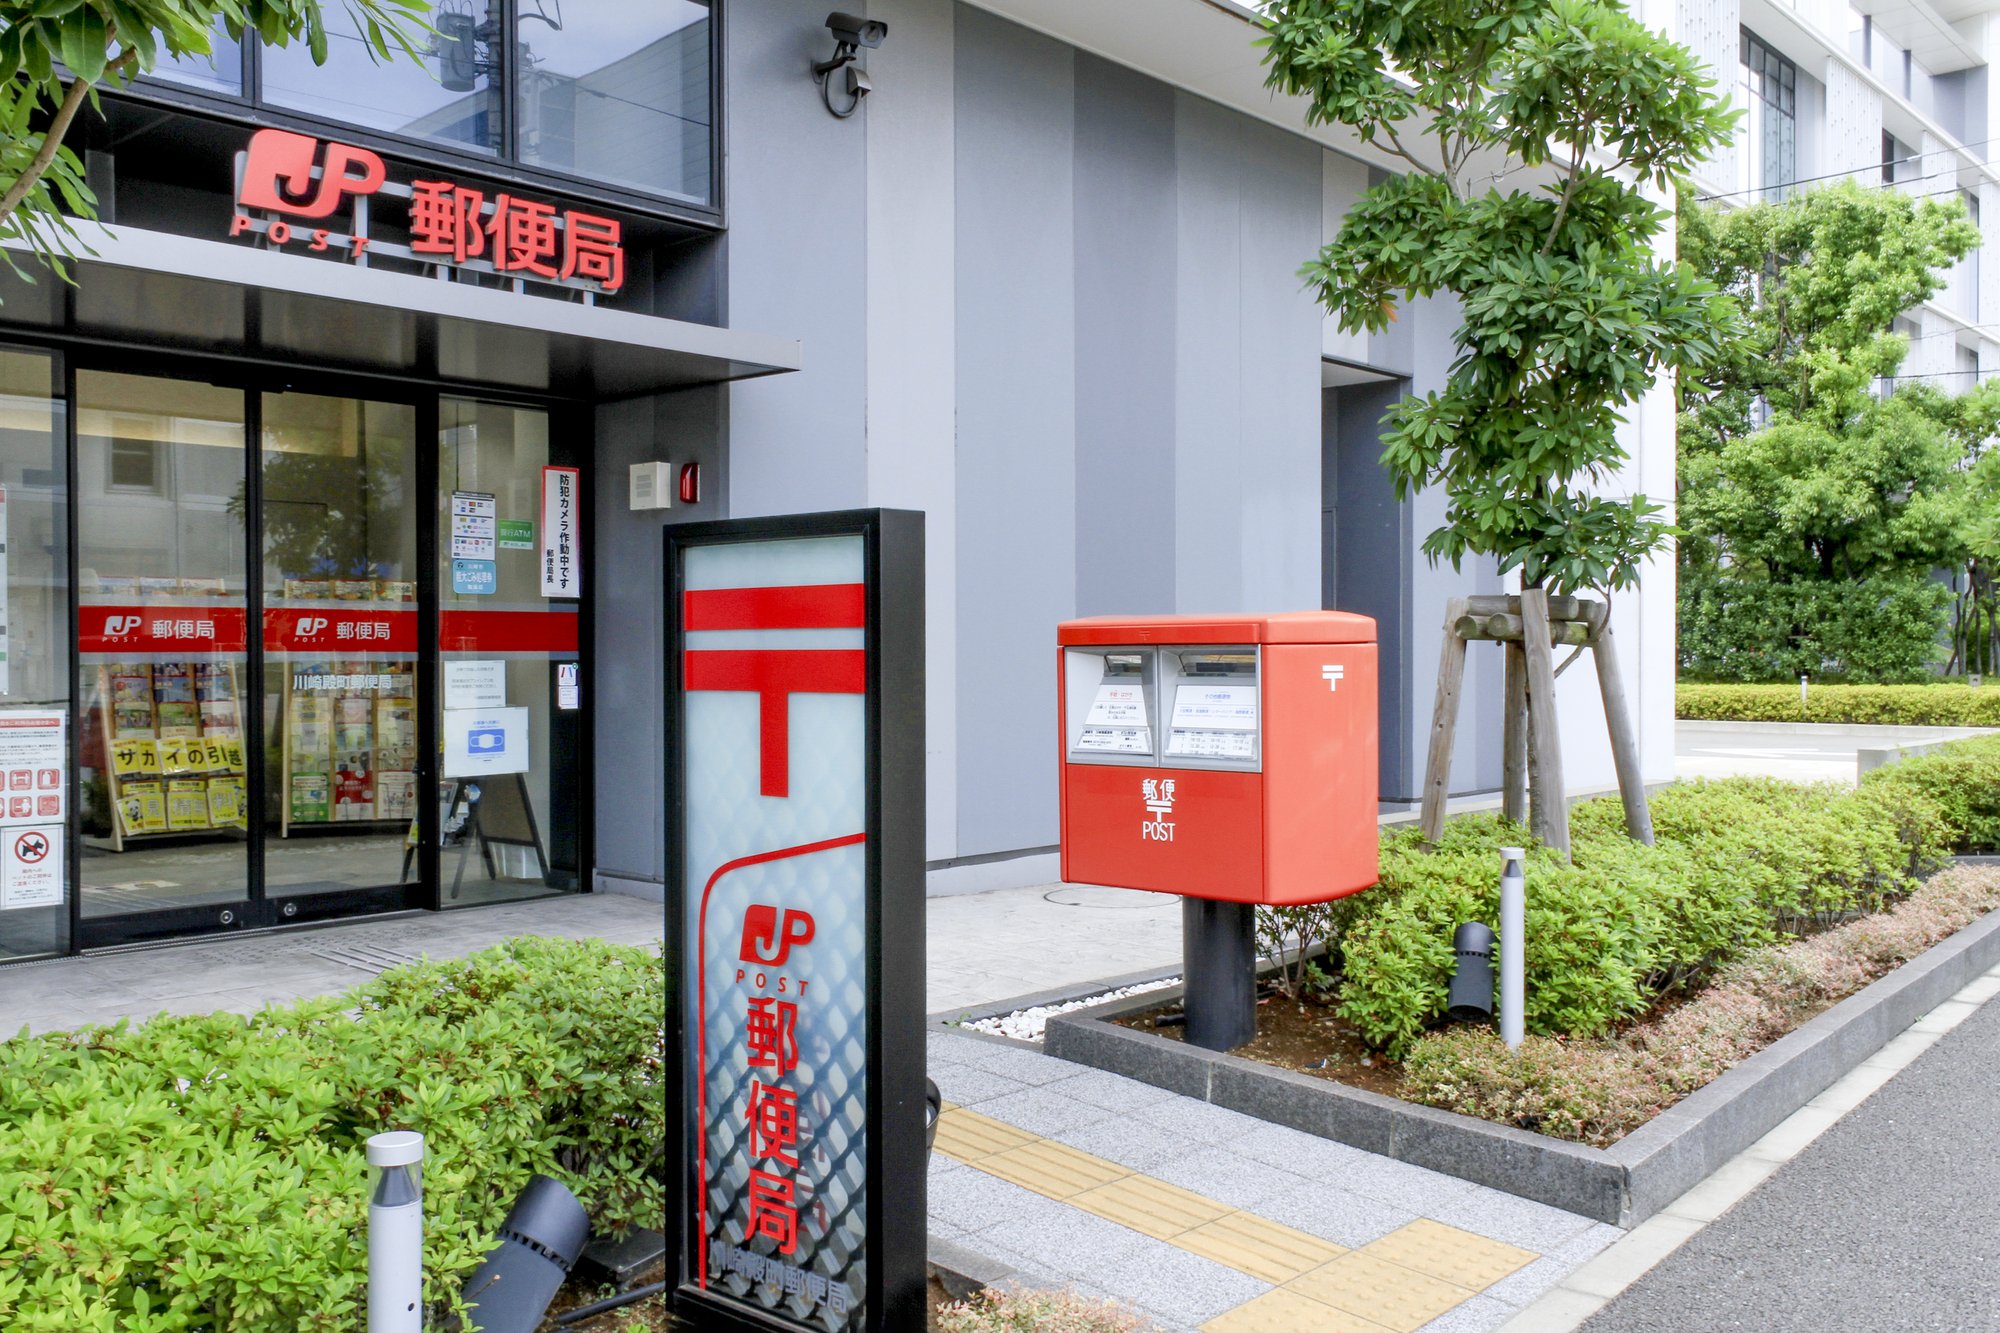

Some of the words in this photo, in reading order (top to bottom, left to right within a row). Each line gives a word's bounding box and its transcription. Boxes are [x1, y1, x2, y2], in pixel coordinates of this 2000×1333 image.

[240, 129, 386, 218] JP
[229, 214, 370, 259] POST
[410, 180, 624, 290] 郵便局
[559, 474, 570, 589] 防犯カメラ作動中です
[546, 549, 555, 584] 郵便局長
[104, 615, 142, 636] JP
[152, 620, 215, 640] 郵便局
[295, 617, 329, 636] JP
[336, 621, 391, 641] 郵便局
[292, 674, 392, 690] 川崎殿町郵便局
[117, 744, 243, 767] サカイの引越
[1142, 779, 1176, 801] 郵便
[1142, 821, 1176, 842] POST
[739, 904, 816, 967] JP
[736, 968, 809, 997] POST
[745, 996, 799, 1255] 郵便局
